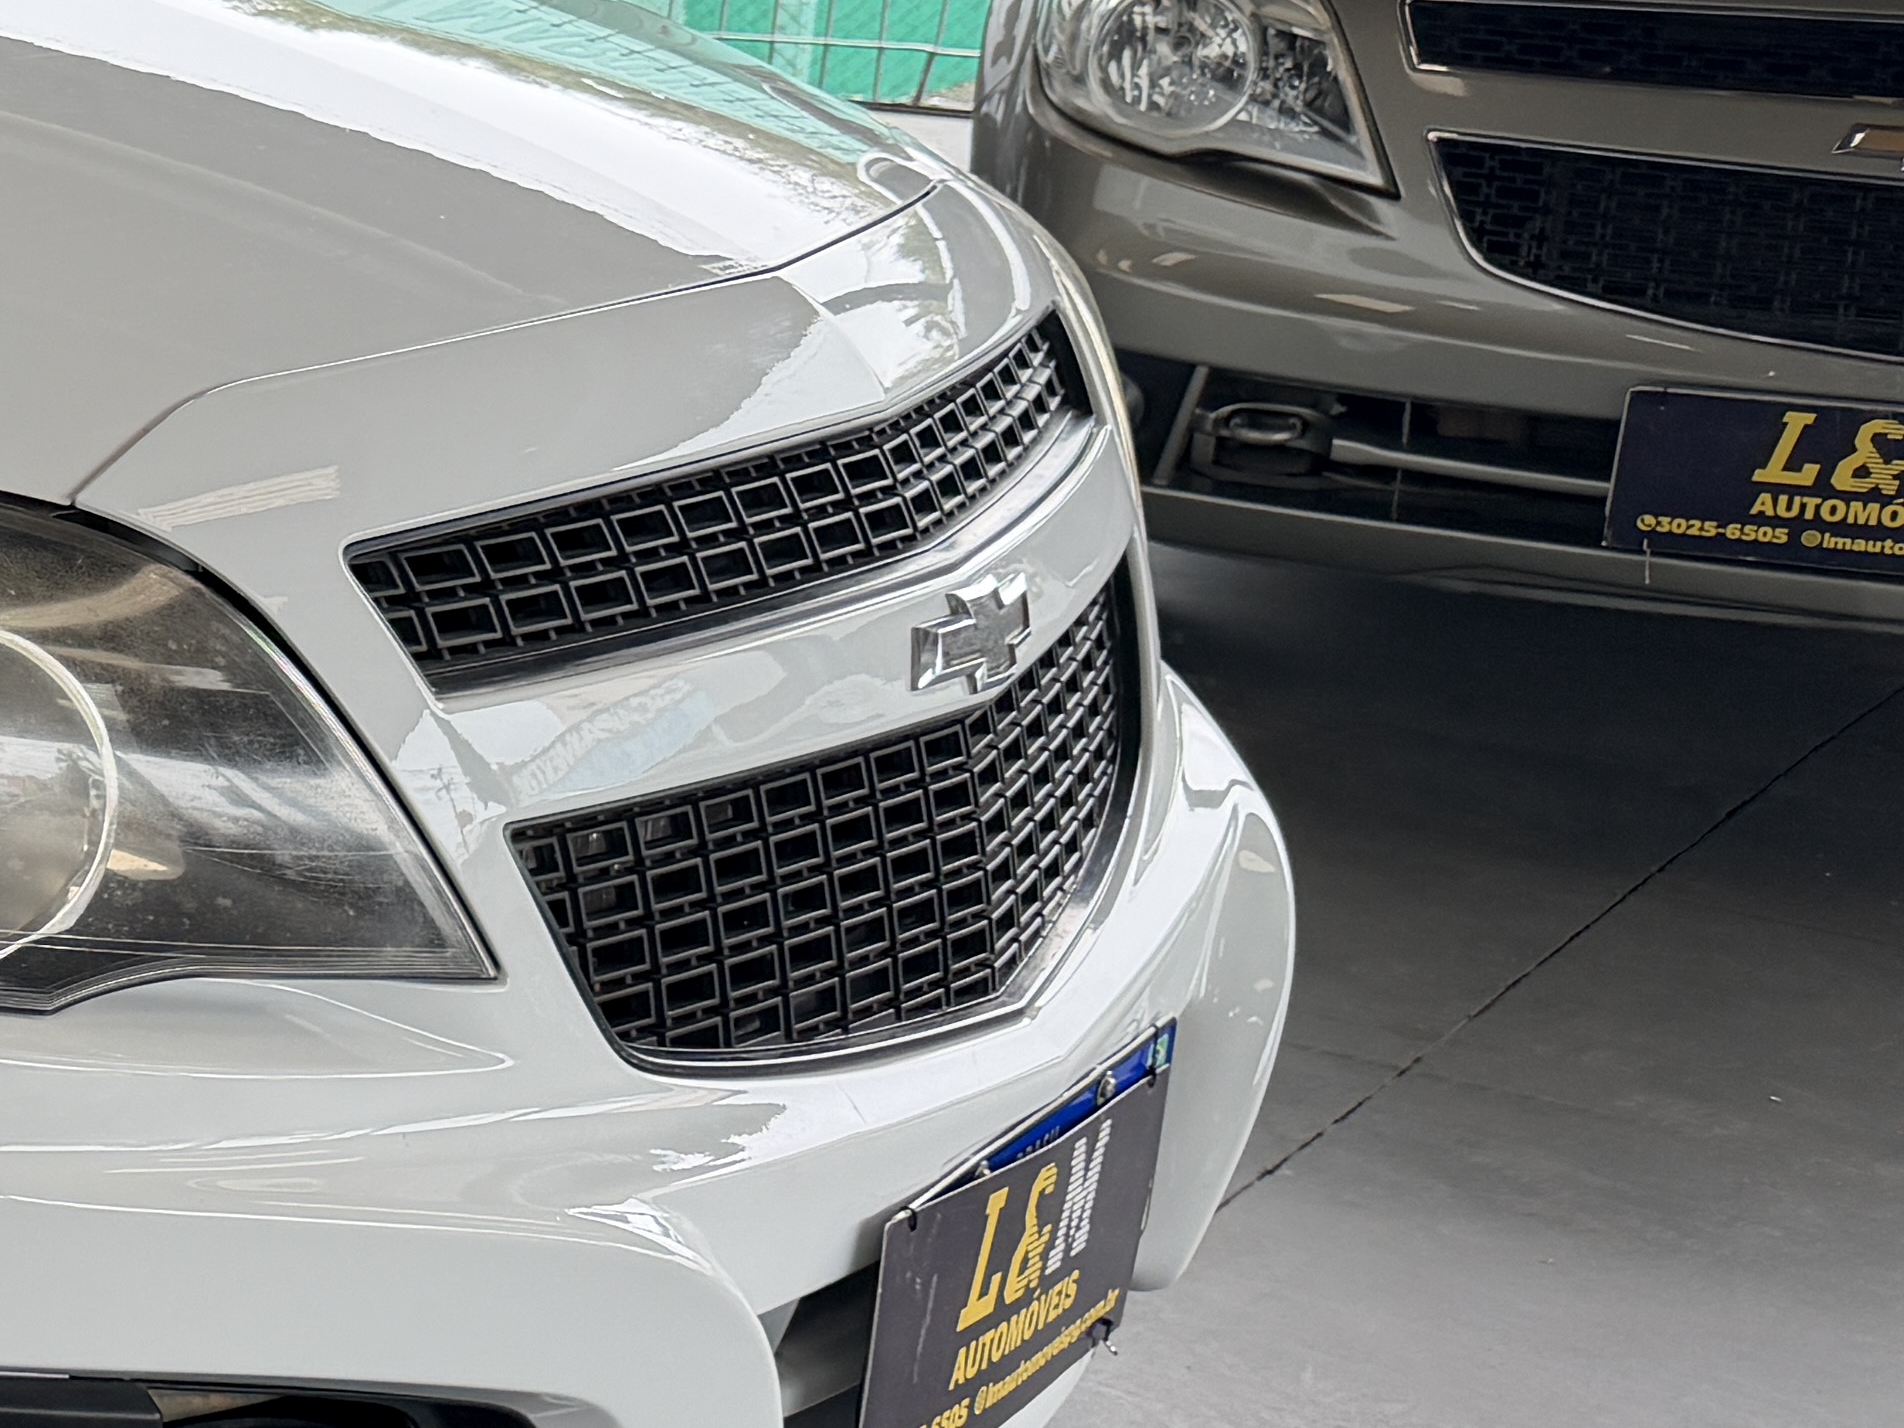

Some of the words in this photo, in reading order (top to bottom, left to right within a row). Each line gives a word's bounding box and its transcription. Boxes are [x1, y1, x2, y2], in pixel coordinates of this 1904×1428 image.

[1655, 516, 1789, 544] 3025-6505
[956, 1118, 1113, 1332] L&M
[949, 1269, 1080, 1391] AUTOMÓVEIS
